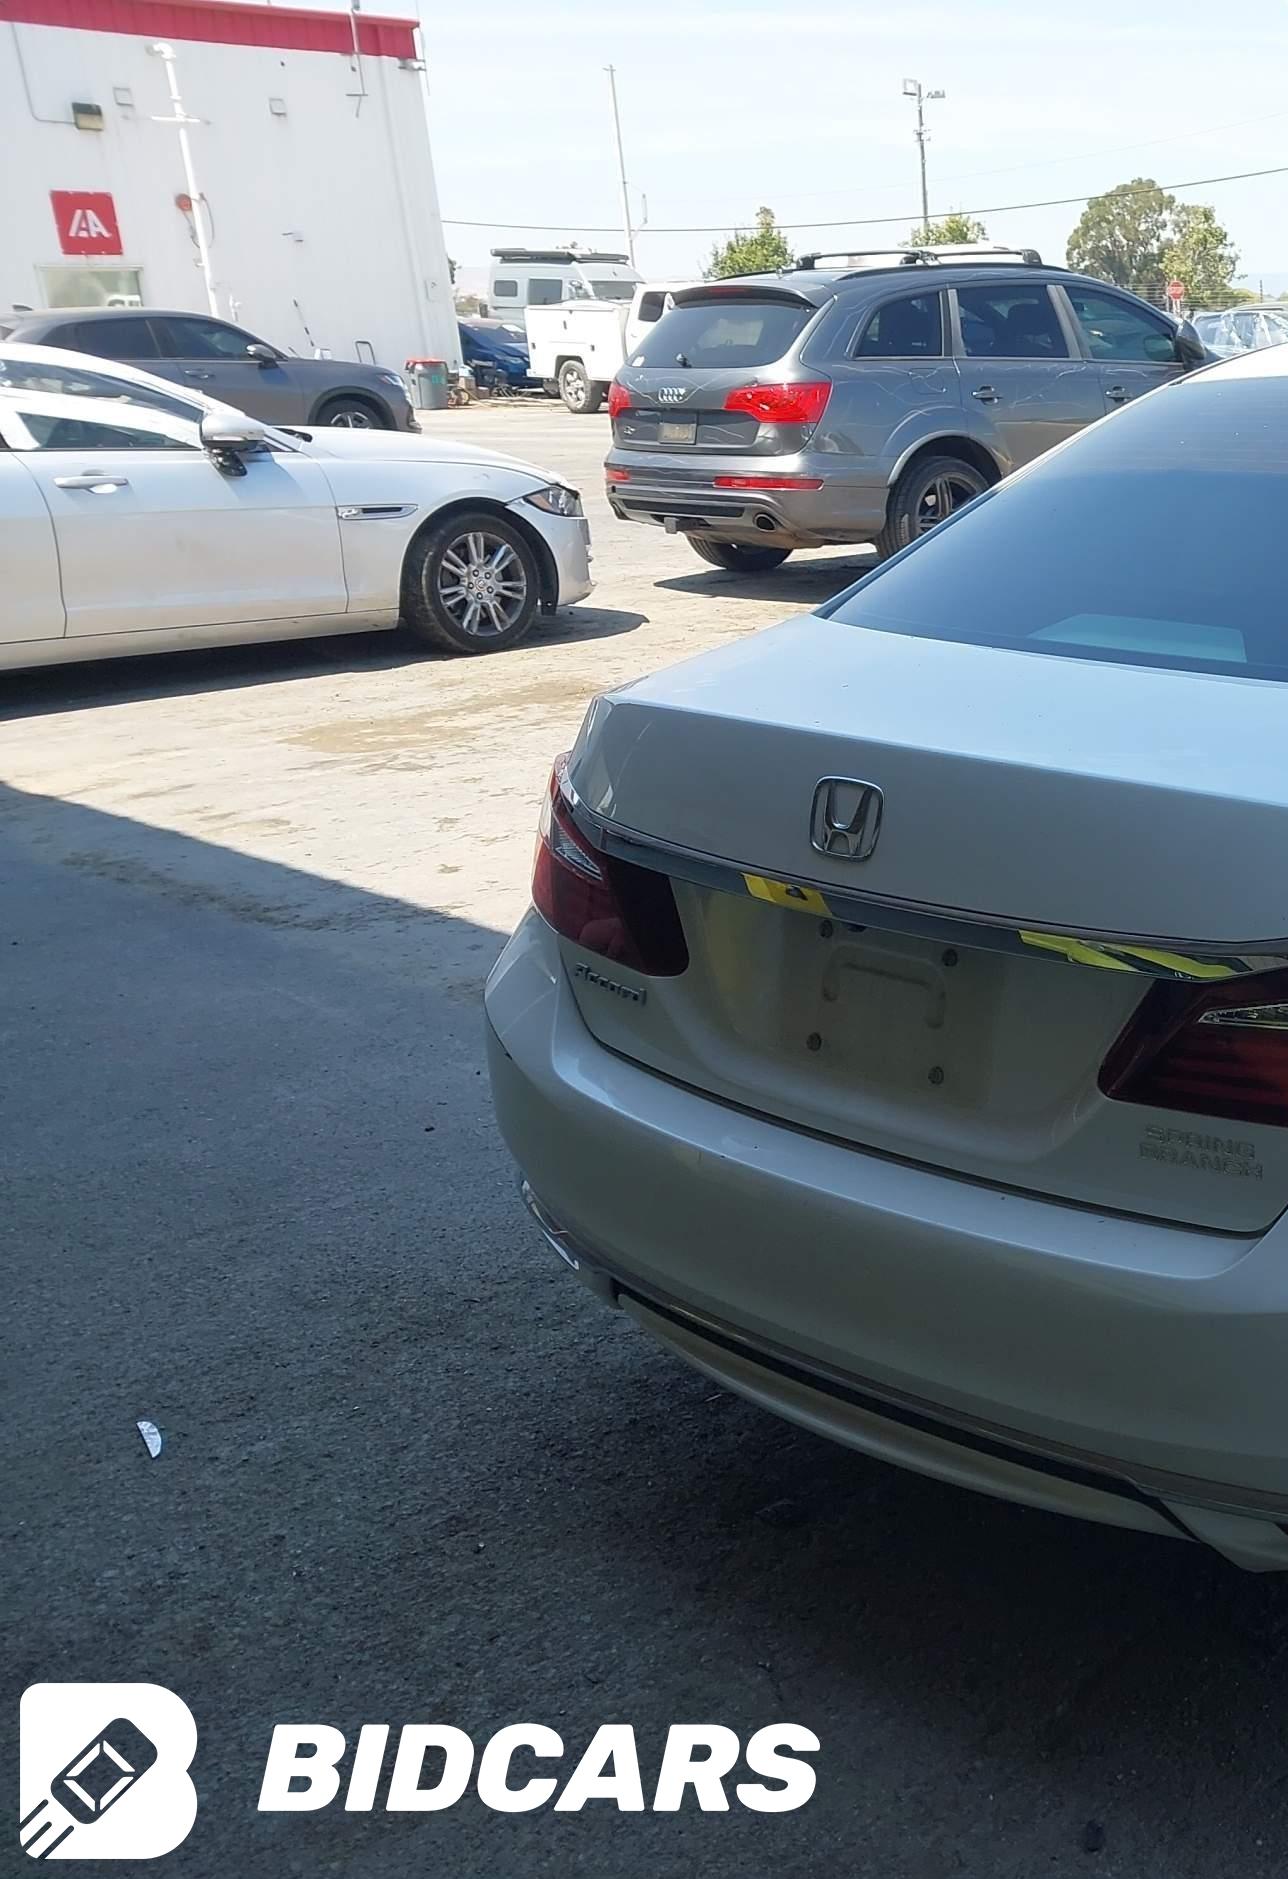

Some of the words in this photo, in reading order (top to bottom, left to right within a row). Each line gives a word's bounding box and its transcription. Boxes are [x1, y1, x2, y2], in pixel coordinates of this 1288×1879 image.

[820, 782, 874, 857] H
[575, 962, 648, 1007] Accord
[1144, 1124, 1256, 1161] SPRING
